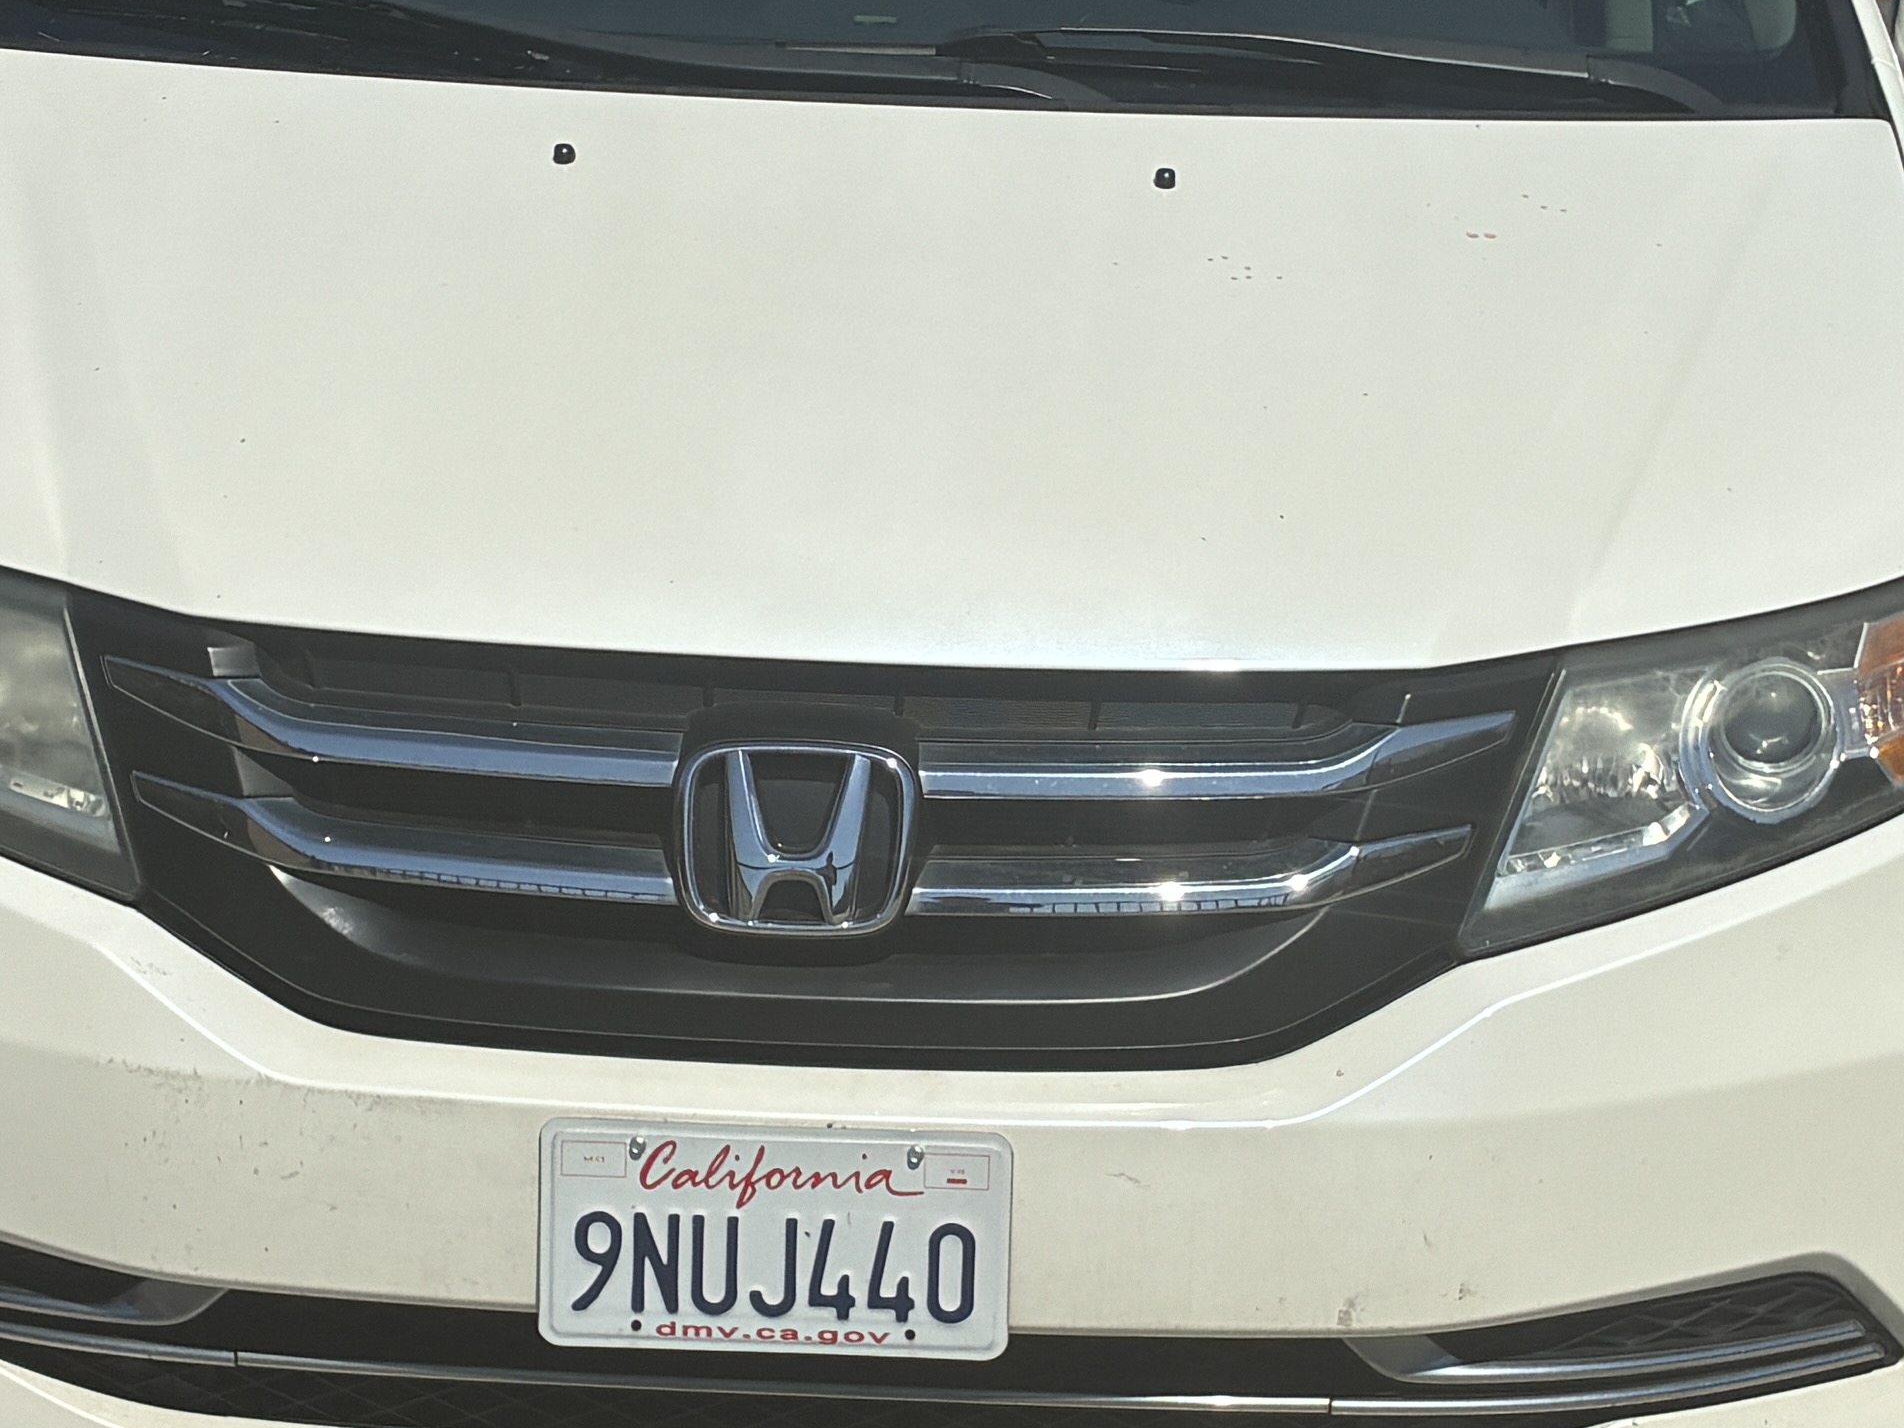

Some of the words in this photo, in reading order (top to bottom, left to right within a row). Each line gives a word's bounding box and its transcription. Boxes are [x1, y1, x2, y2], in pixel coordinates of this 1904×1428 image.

[639, 1140, 925, 1209] California
[571, 1210, 976, 1324] 9NUJ440
[655, 1321, 891, 1345] dmv.ca.gov
